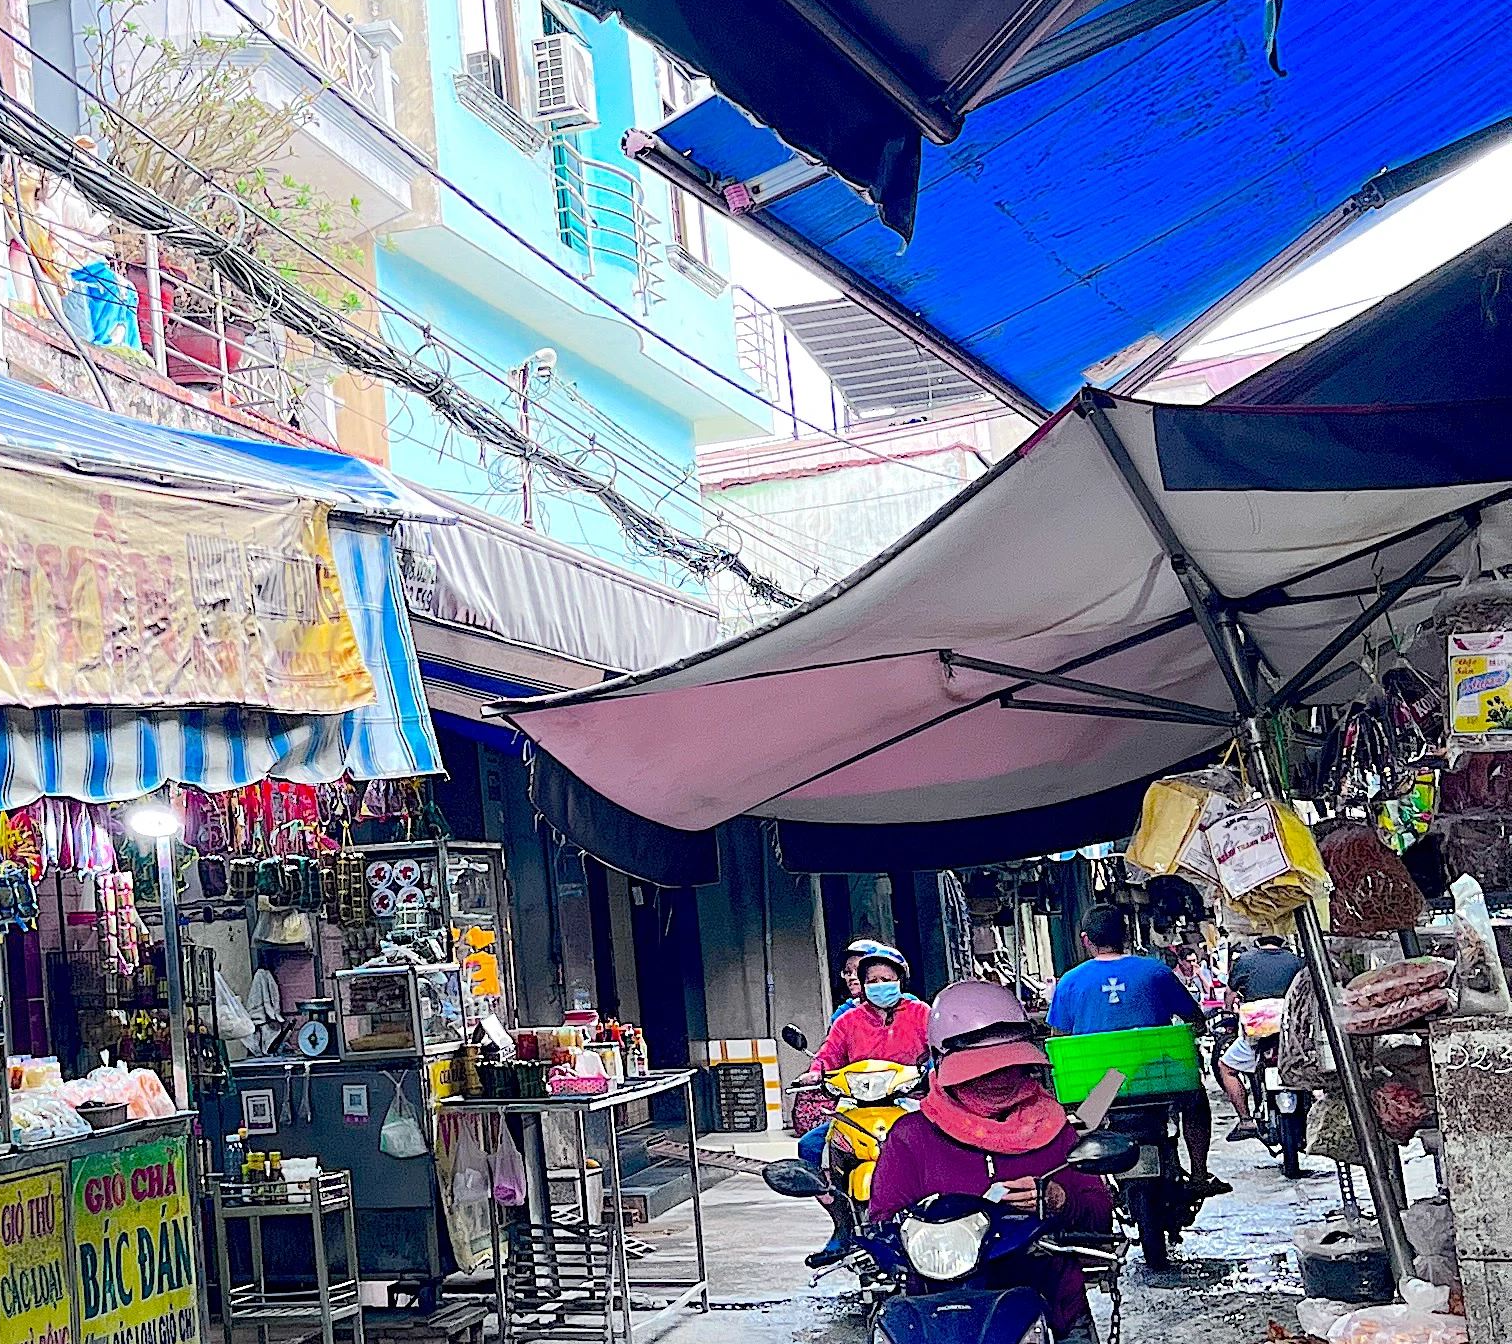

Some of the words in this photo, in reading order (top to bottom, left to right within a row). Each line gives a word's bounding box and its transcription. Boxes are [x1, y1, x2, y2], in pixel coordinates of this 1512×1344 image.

[1, 1190, 25, 1246] GIÒ
[85, 1164, 127, 1215] GIÒ
[0, 1262, 31, 1318] CÁC
[31, 1259, 64, 1310] LOẠI
[79, 1216, 133, 1321] BÁC
[136, 1203, 194, 1299] ĐÁN
